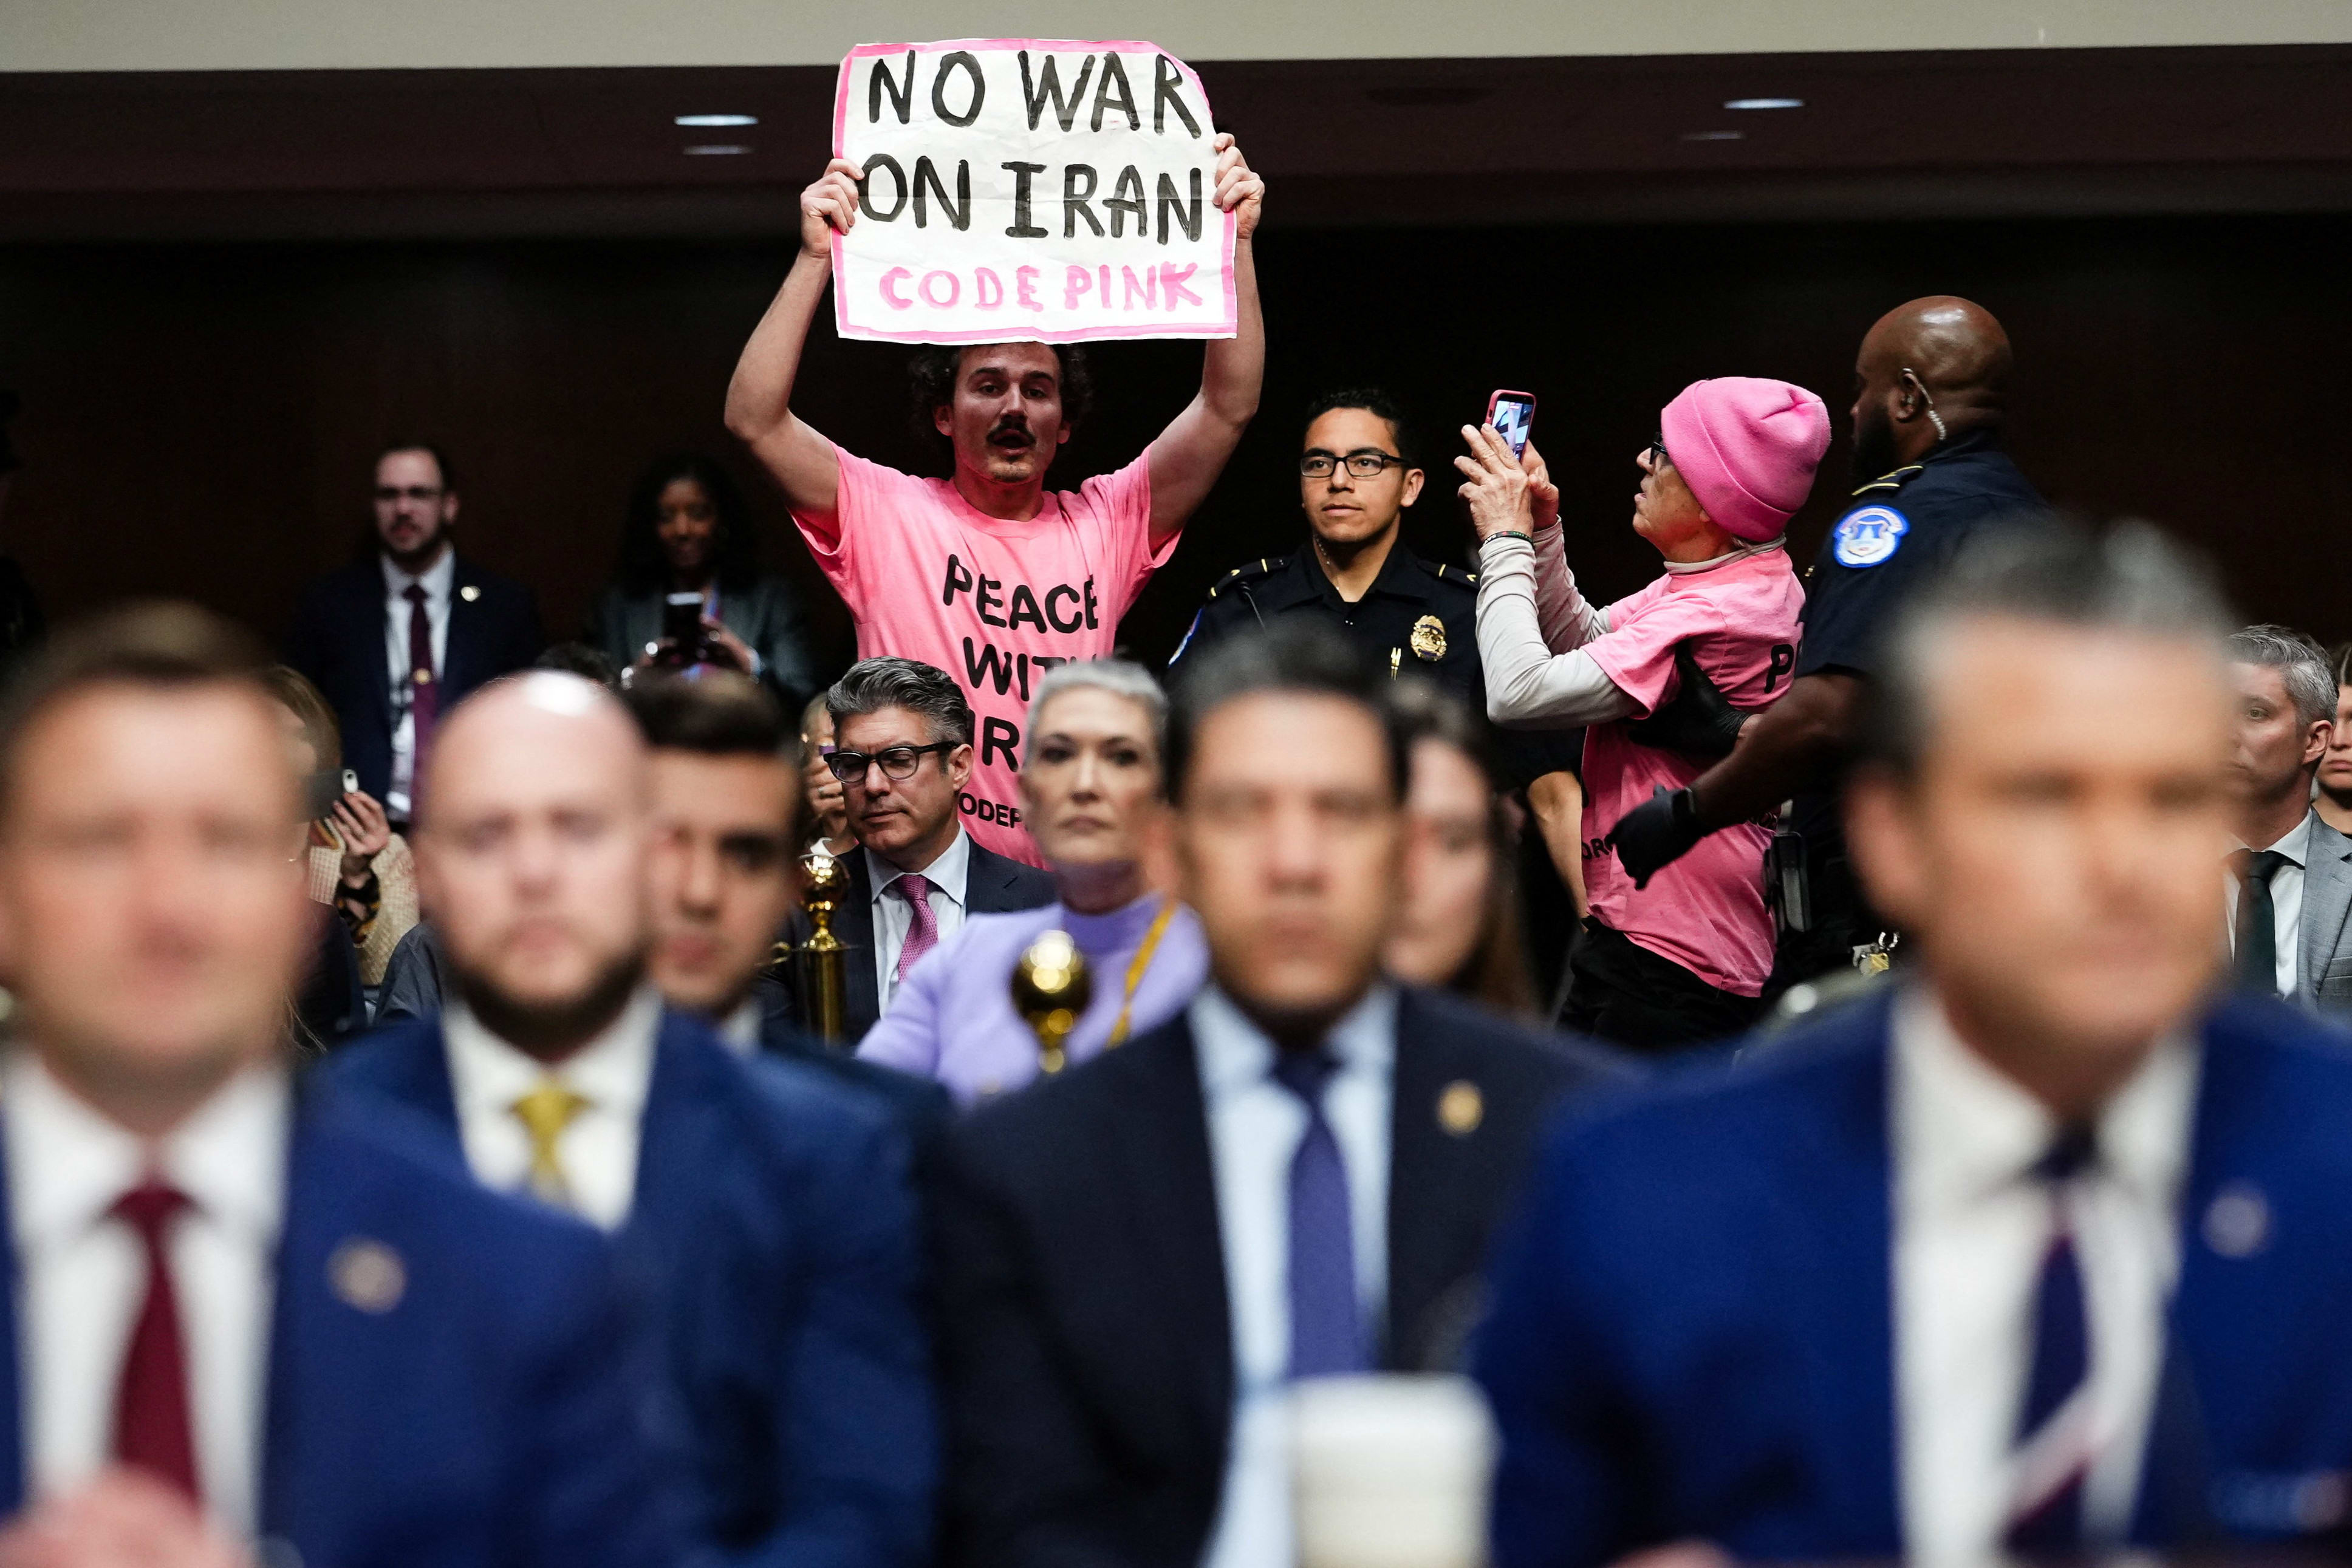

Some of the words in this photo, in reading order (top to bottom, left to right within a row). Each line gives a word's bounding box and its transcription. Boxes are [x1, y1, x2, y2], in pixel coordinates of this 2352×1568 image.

[869, 50, 985, 128] NO
[1017, 50, 1202, 139] WAR
[857, 153, 971, 231] ON
[1001, 161, 1202, 245] IRAN
[879, 265, 1044, 312] CODE
[1064, 262, 1203, 312] PINK
[963, 636, 1097, 702] WIT
